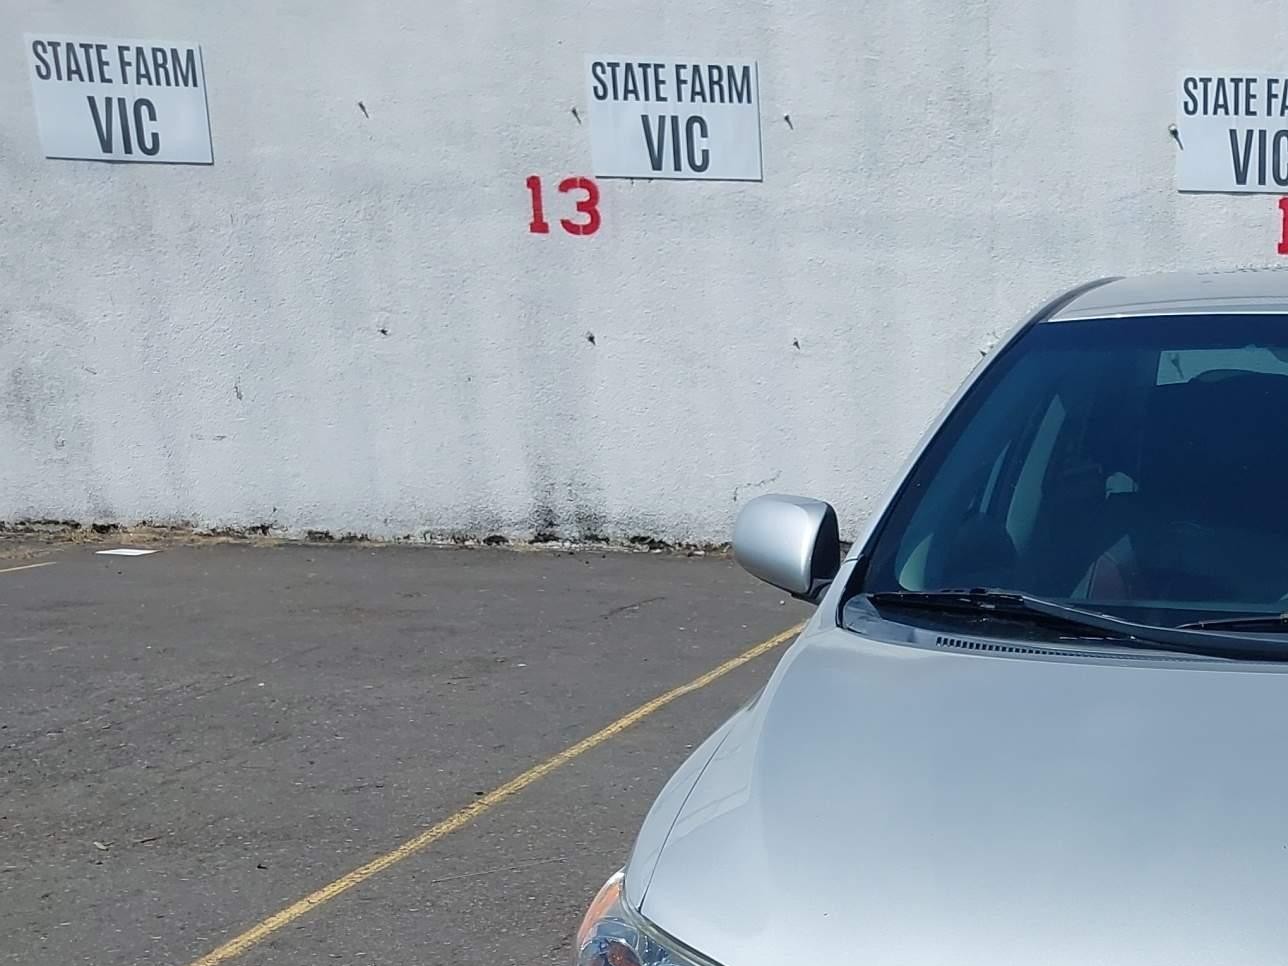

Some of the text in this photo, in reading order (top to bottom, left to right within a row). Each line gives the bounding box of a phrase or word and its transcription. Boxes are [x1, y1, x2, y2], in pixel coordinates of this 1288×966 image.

[32, 40, 199, 88] STATE FARM
[591, 61, 752, 105] STATE FARM
[1183, 77, 1258, 117] STATE
[86, 95, 160, 157] VIC
[640, 114, 710, 173] VIC
[526, 175, 602, 238] 13
